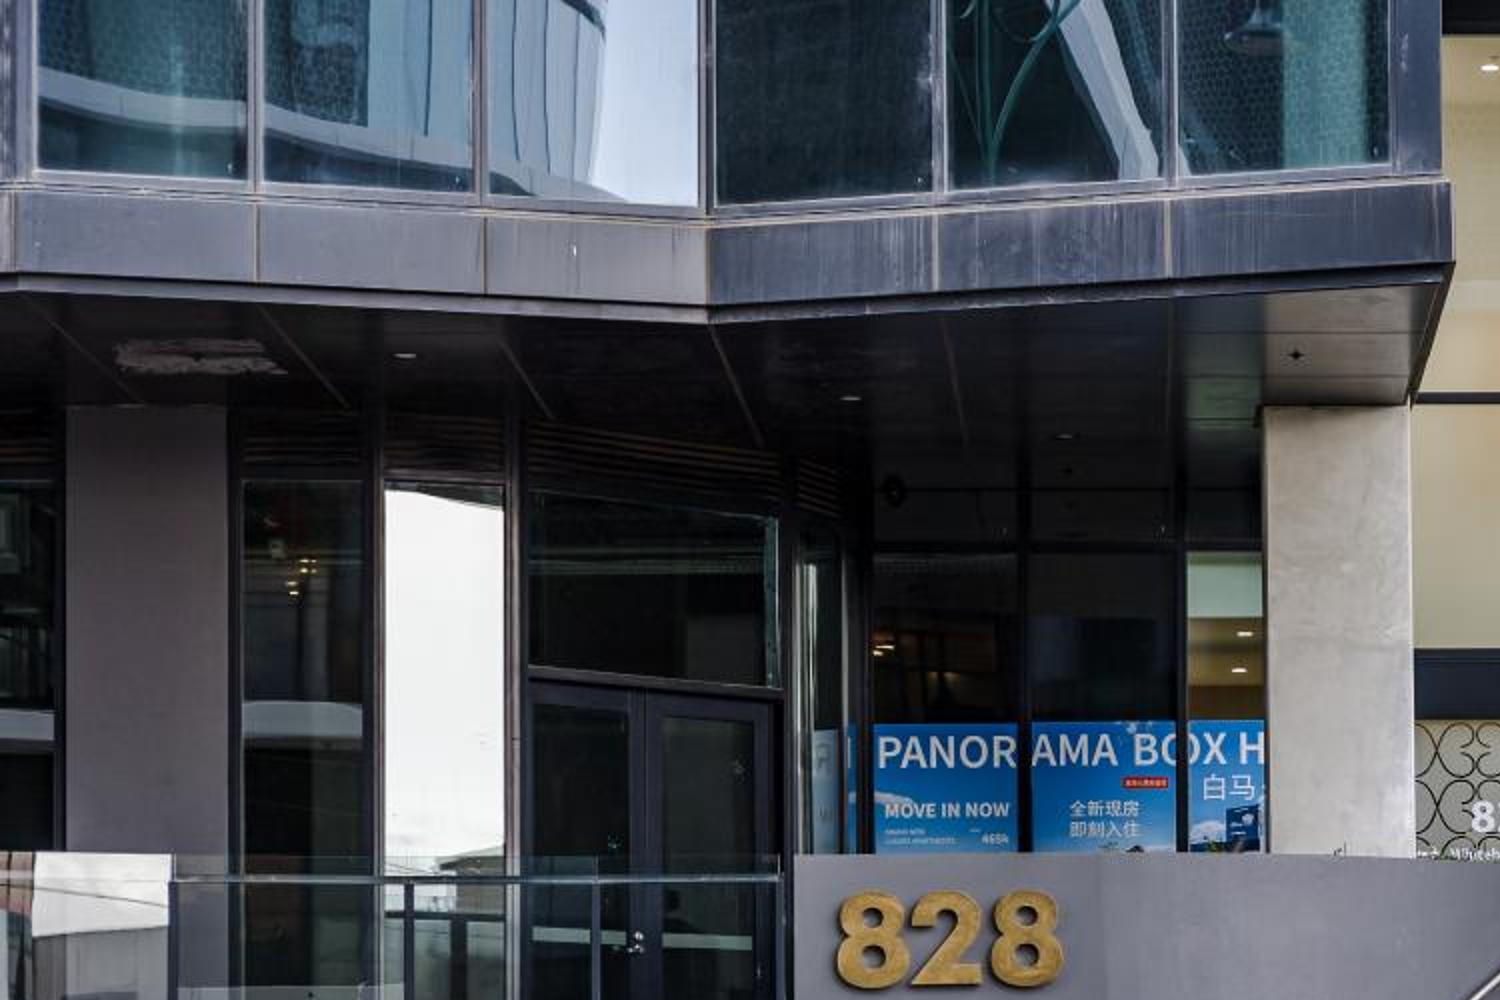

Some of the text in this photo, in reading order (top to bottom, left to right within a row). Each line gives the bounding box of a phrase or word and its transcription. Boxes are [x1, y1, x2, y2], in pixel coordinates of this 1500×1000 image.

[885, 801, 1009, 818] MOVE IN NOW
[835, 889, 1064, 989] 828
